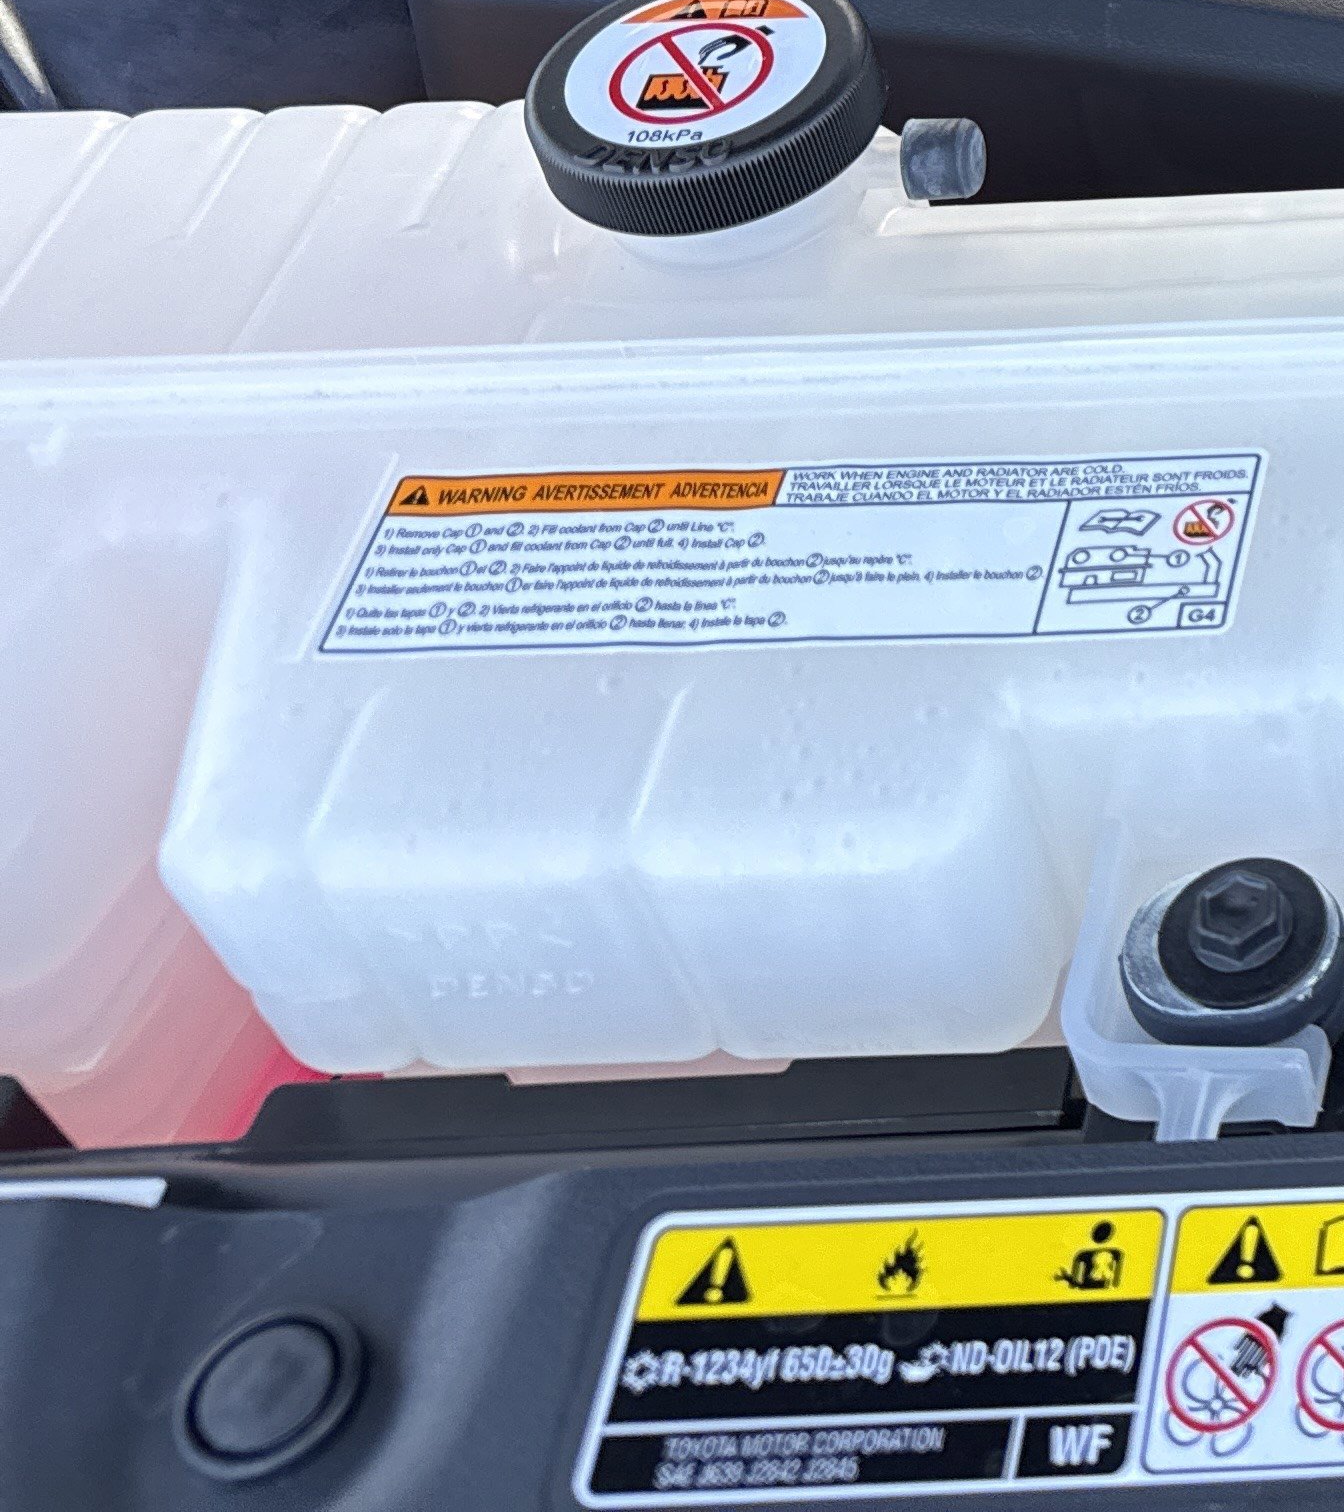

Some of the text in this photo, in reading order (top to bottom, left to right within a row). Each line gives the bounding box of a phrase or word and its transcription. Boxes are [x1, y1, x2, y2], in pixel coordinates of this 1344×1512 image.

[627, 129, 703, 143] 108kPa
[574, 140, 728, 174] DENSO
[790, 470, 1248, 491] TRAVAILLER LORSQUE LE MOTEUR ET LE RADIATEUR SONT FROIDS.
[793, 465, 1124, 481] WORK WHEN ENGINE AND RADIATOR ARE COLD.
[437, 482, 769, 503] WARNING AVERTISSEMENT ADVERTENCIA
[787, 493, 849, 502] TRABAJE
[852, 491, 913, 501] CUANDO
[917, 491, 933, 500] EL
[937, 489, 991, 499] MOTOR
[994, 489, 1004, 498] Y
[1006, 489, 1023, 498] EL
[1027, 487, 1100, 498] RADIADOR
[1104, 484, 1152, 494] ESTÉN
[396, 528, 440, 539] Remove
[599, 523, 622, 533] from
[564, 539, 588, 550] from
[1188, 608, 1215, 622] G4
[780, 1343, 895, 1385] 650±30g
[949, 1337, 1065, 1375] ND-OIL12
[1065, 1335, 1136, 1377] (POE)
[664, 1427, 946, 1460] TOYOTA MOTOR CORPORATION
[1050, 1424, 1113, 1467] WF
